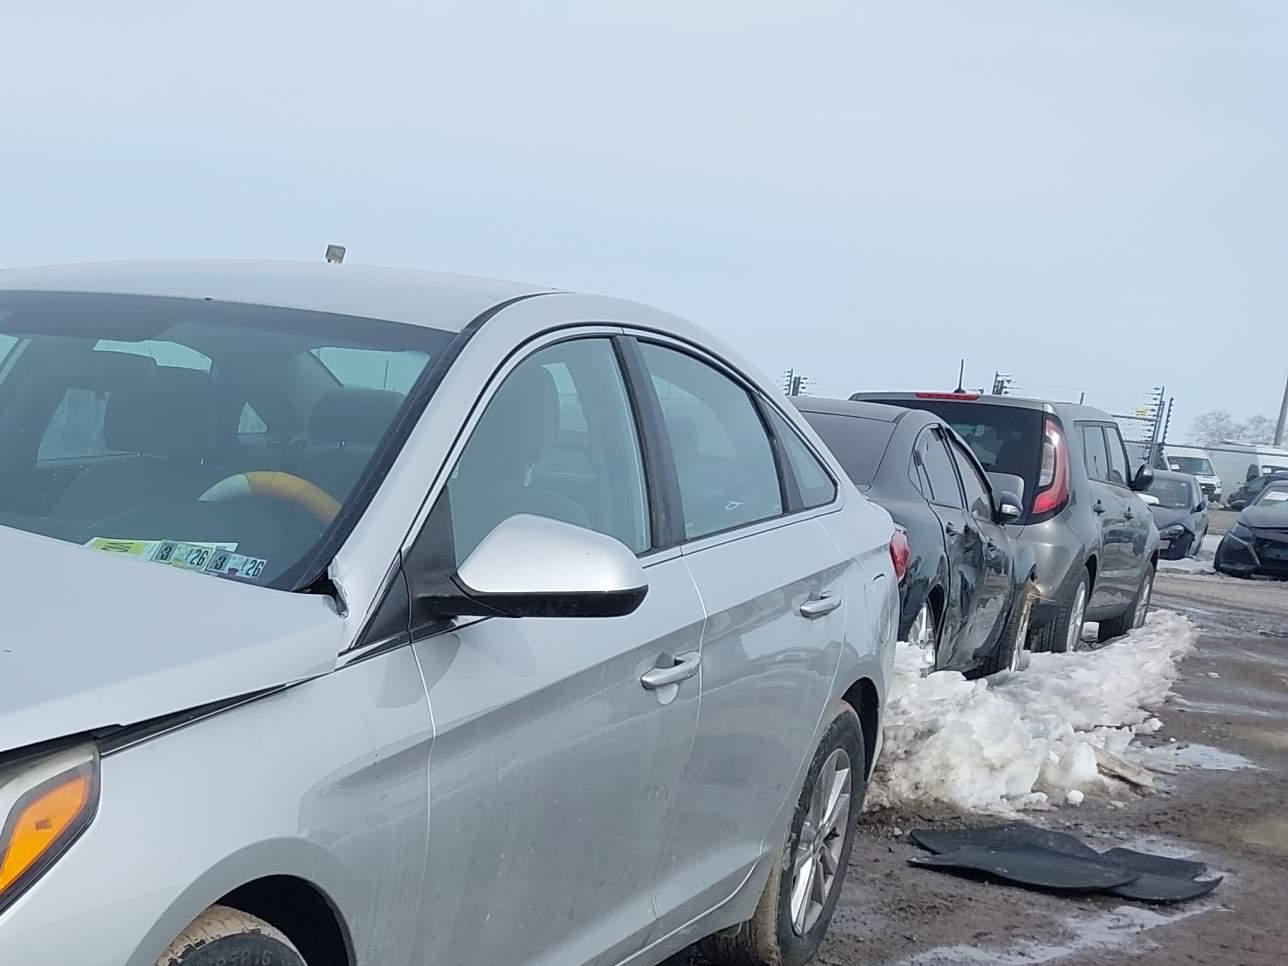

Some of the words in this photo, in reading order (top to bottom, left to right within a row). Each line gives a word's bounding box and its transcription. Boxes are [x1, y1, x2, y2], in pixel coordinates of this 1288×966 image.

[161, 546, 172, 561] 3
[190, 549, 209, 566] 26
[214, 556, 226, 570] 3
[245, 560, 264, 577] 26
